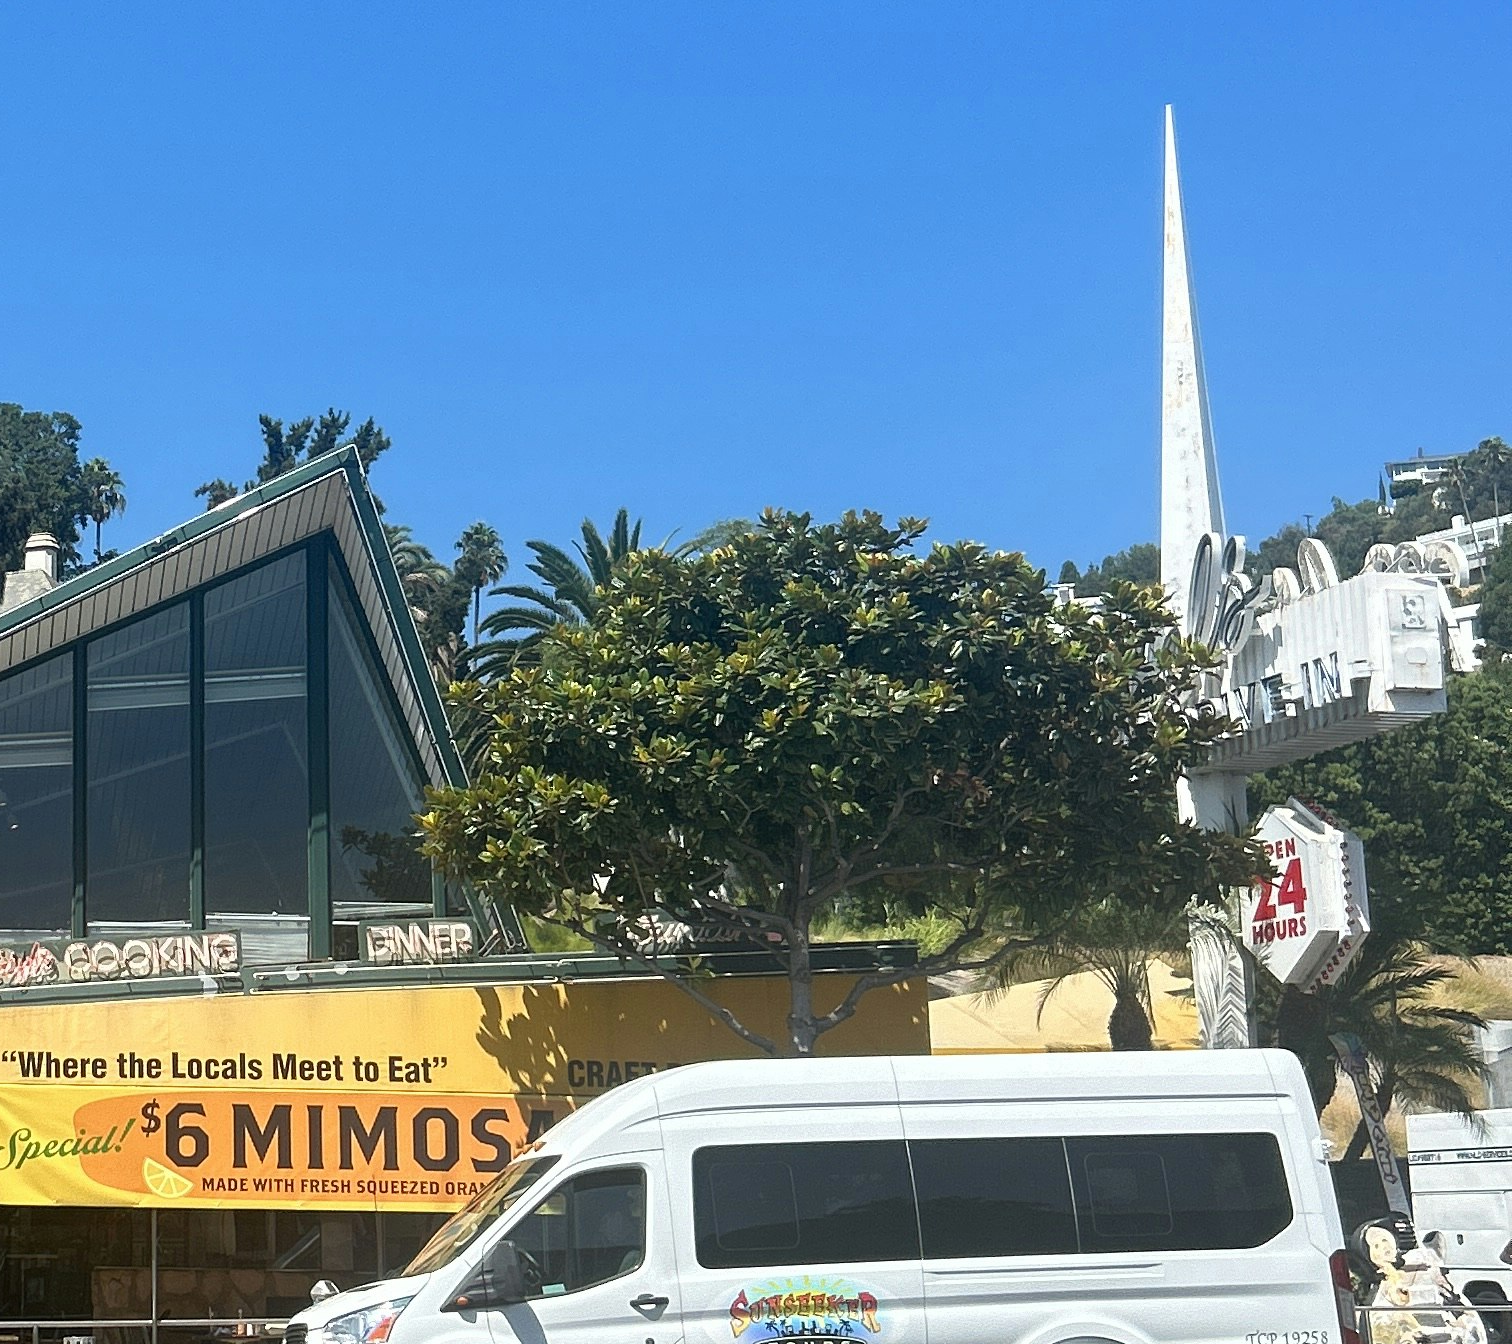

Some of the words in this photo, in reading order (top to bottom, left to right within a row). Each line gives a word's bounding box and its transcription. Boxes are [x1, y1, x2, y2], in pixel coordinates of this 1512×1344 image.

[1262, 837, 1297, 860] PEN
[1252, 857, 1308, 923] 24
[366, 921, 472, 963] DINNER
[1252, 916, 1307, 945] HOURS
[65, 933, 237, 981] COOKING
[1, 1050, 108, 1078] “Where
[116, 1052, 162, 1078] the
[171, 1052, 263, 1080] Locals
[272, 1053, 344, 1081] Meet
[352, 1055, 380, 1082] to
[388, 1055, 448, 1084] Eat”
[140, 1098, 210, 1168] $6
[202, 1177, 248, 1193] MADE
[252, 1178, 295, 1193] WITH
[300, 1179, 351, 1194] FRESH
[357, 1180, 440, 1196] SQUEEZED
[729, 1288, 881, 1339] SUNSEEKER
